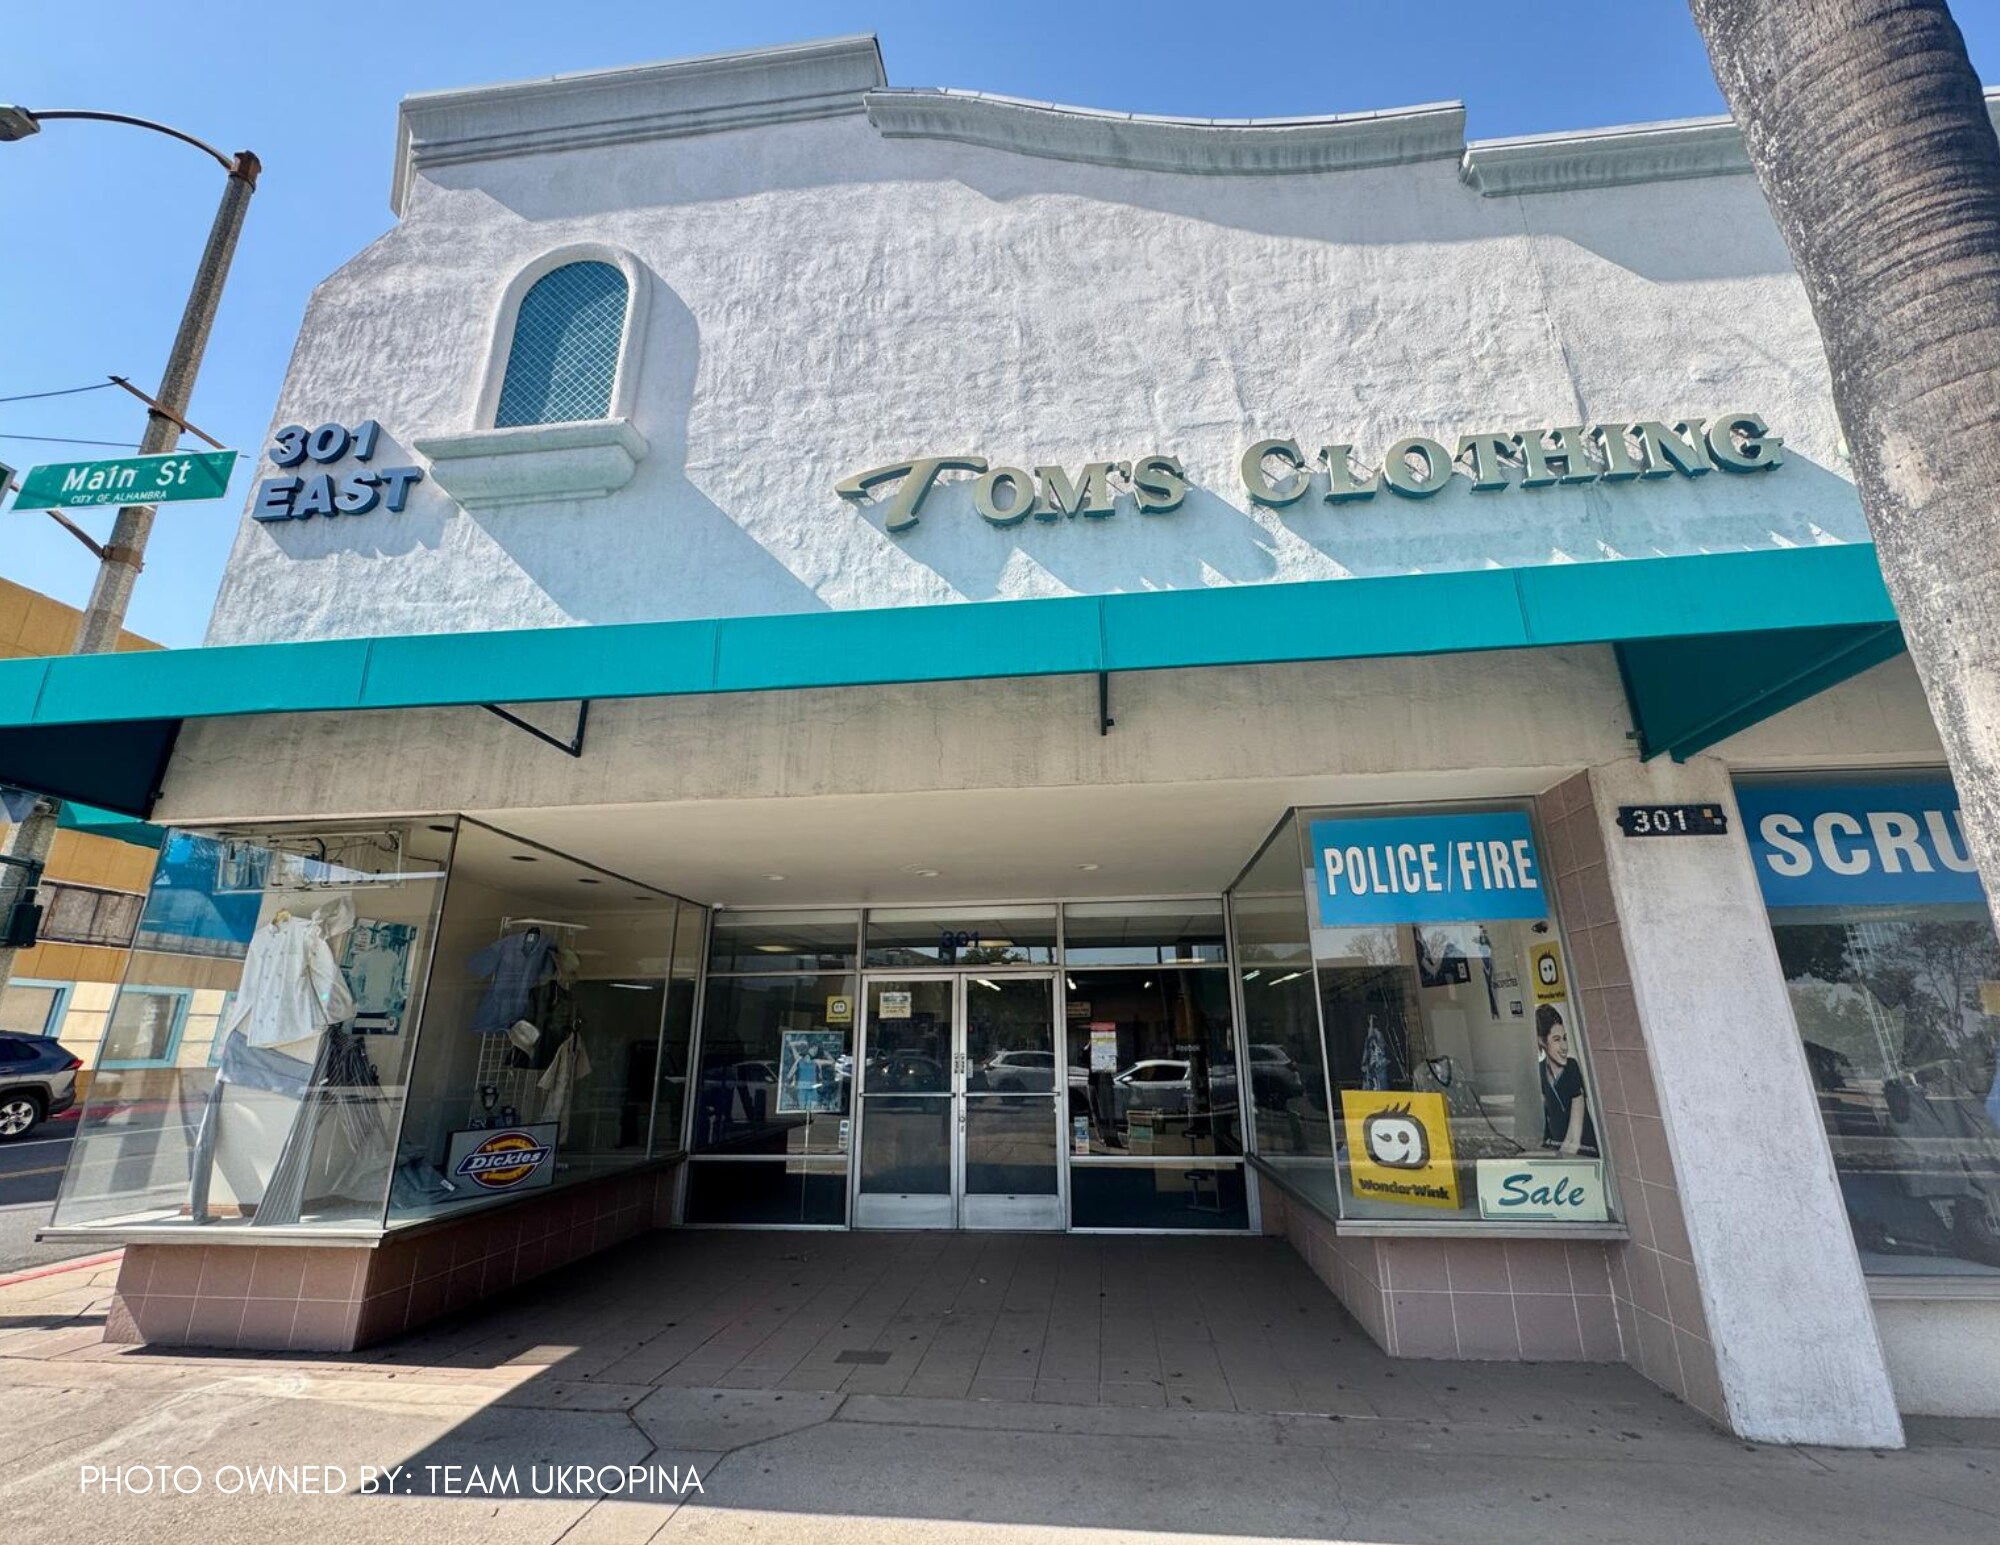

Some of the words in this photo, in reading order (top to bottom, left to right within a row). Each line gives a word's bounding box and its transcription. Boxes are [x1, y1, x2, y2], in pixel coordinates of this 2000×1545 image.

[269, 420, 380, 468] 301
[61, 465, 136, 493] Main
[156, 459, 192, 486] St
[835, 455, 1186, 533] TOM'S
[1241, 413, 1785, 507] CLOTHING
[70, 494, 94, 505] CITY
[96, 493, 111, 503] OF
[112, 490, 167, 502] ALHAMBRA
[252, 466, 423, 522] EAST
[1632, 808, 1688, 834] 301
[1324, 839, 1538, 896] POLICE/FIRE
[942, 930, 979, 948] 301
[468, 1151, 541, 1170] Dickies
[1358, 1178, 1449, 1200] WonderWink
[1498, 1173, 1585, 1207] Sale
